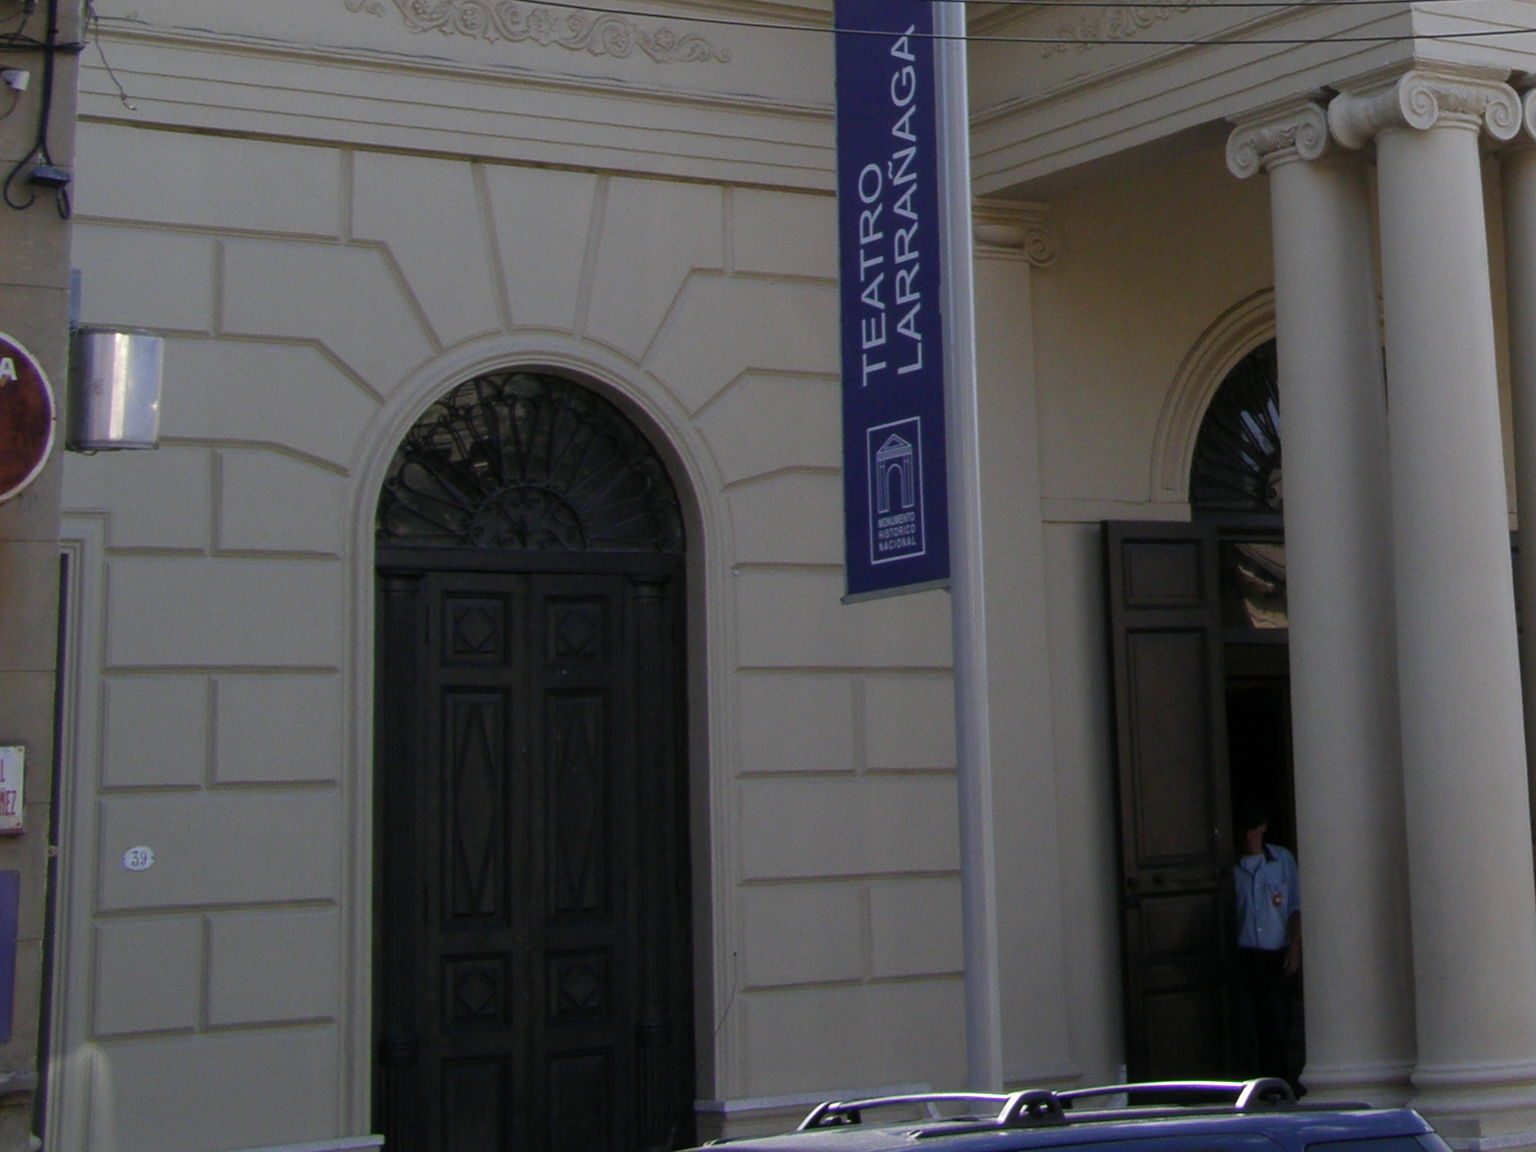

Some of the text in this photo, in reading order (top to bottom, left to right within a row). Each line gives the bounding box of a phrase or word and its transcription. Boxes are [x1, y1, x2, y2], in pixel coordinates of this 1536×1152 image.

[888, 24, 922, 375] LARRAÑAGA
[858, 163, 887, 387] TEATRO
[878, 535, 917, 552] NACIONAL
[130, 850, 148, 866] 39
